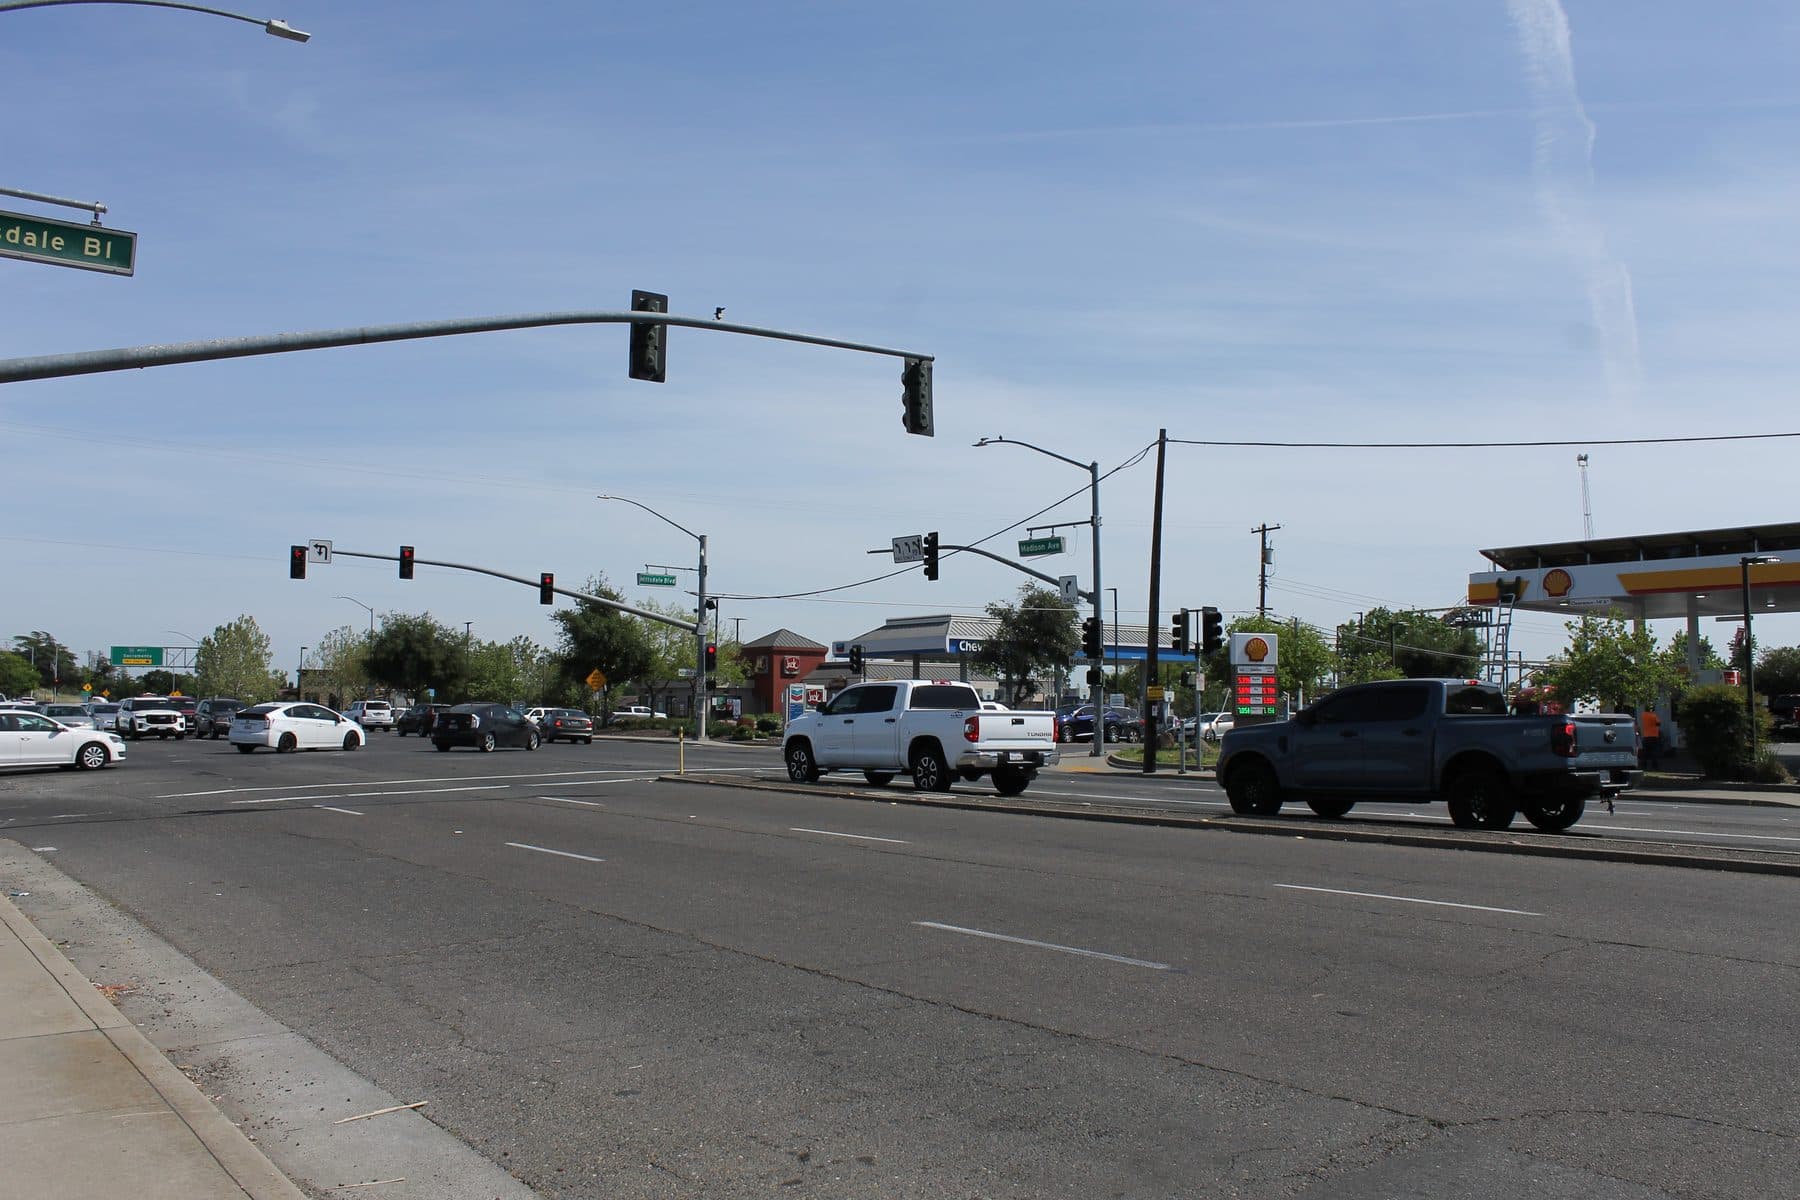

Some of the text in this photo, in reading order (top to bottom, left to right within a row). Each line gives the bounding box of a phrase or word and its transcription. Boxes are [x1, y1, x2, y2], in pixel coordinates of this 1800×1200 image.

[0, 226, 65, 251] dale
[1020, 542, 1060, 553] Madison Ave
[664, 577, 676, 585] Blvd
